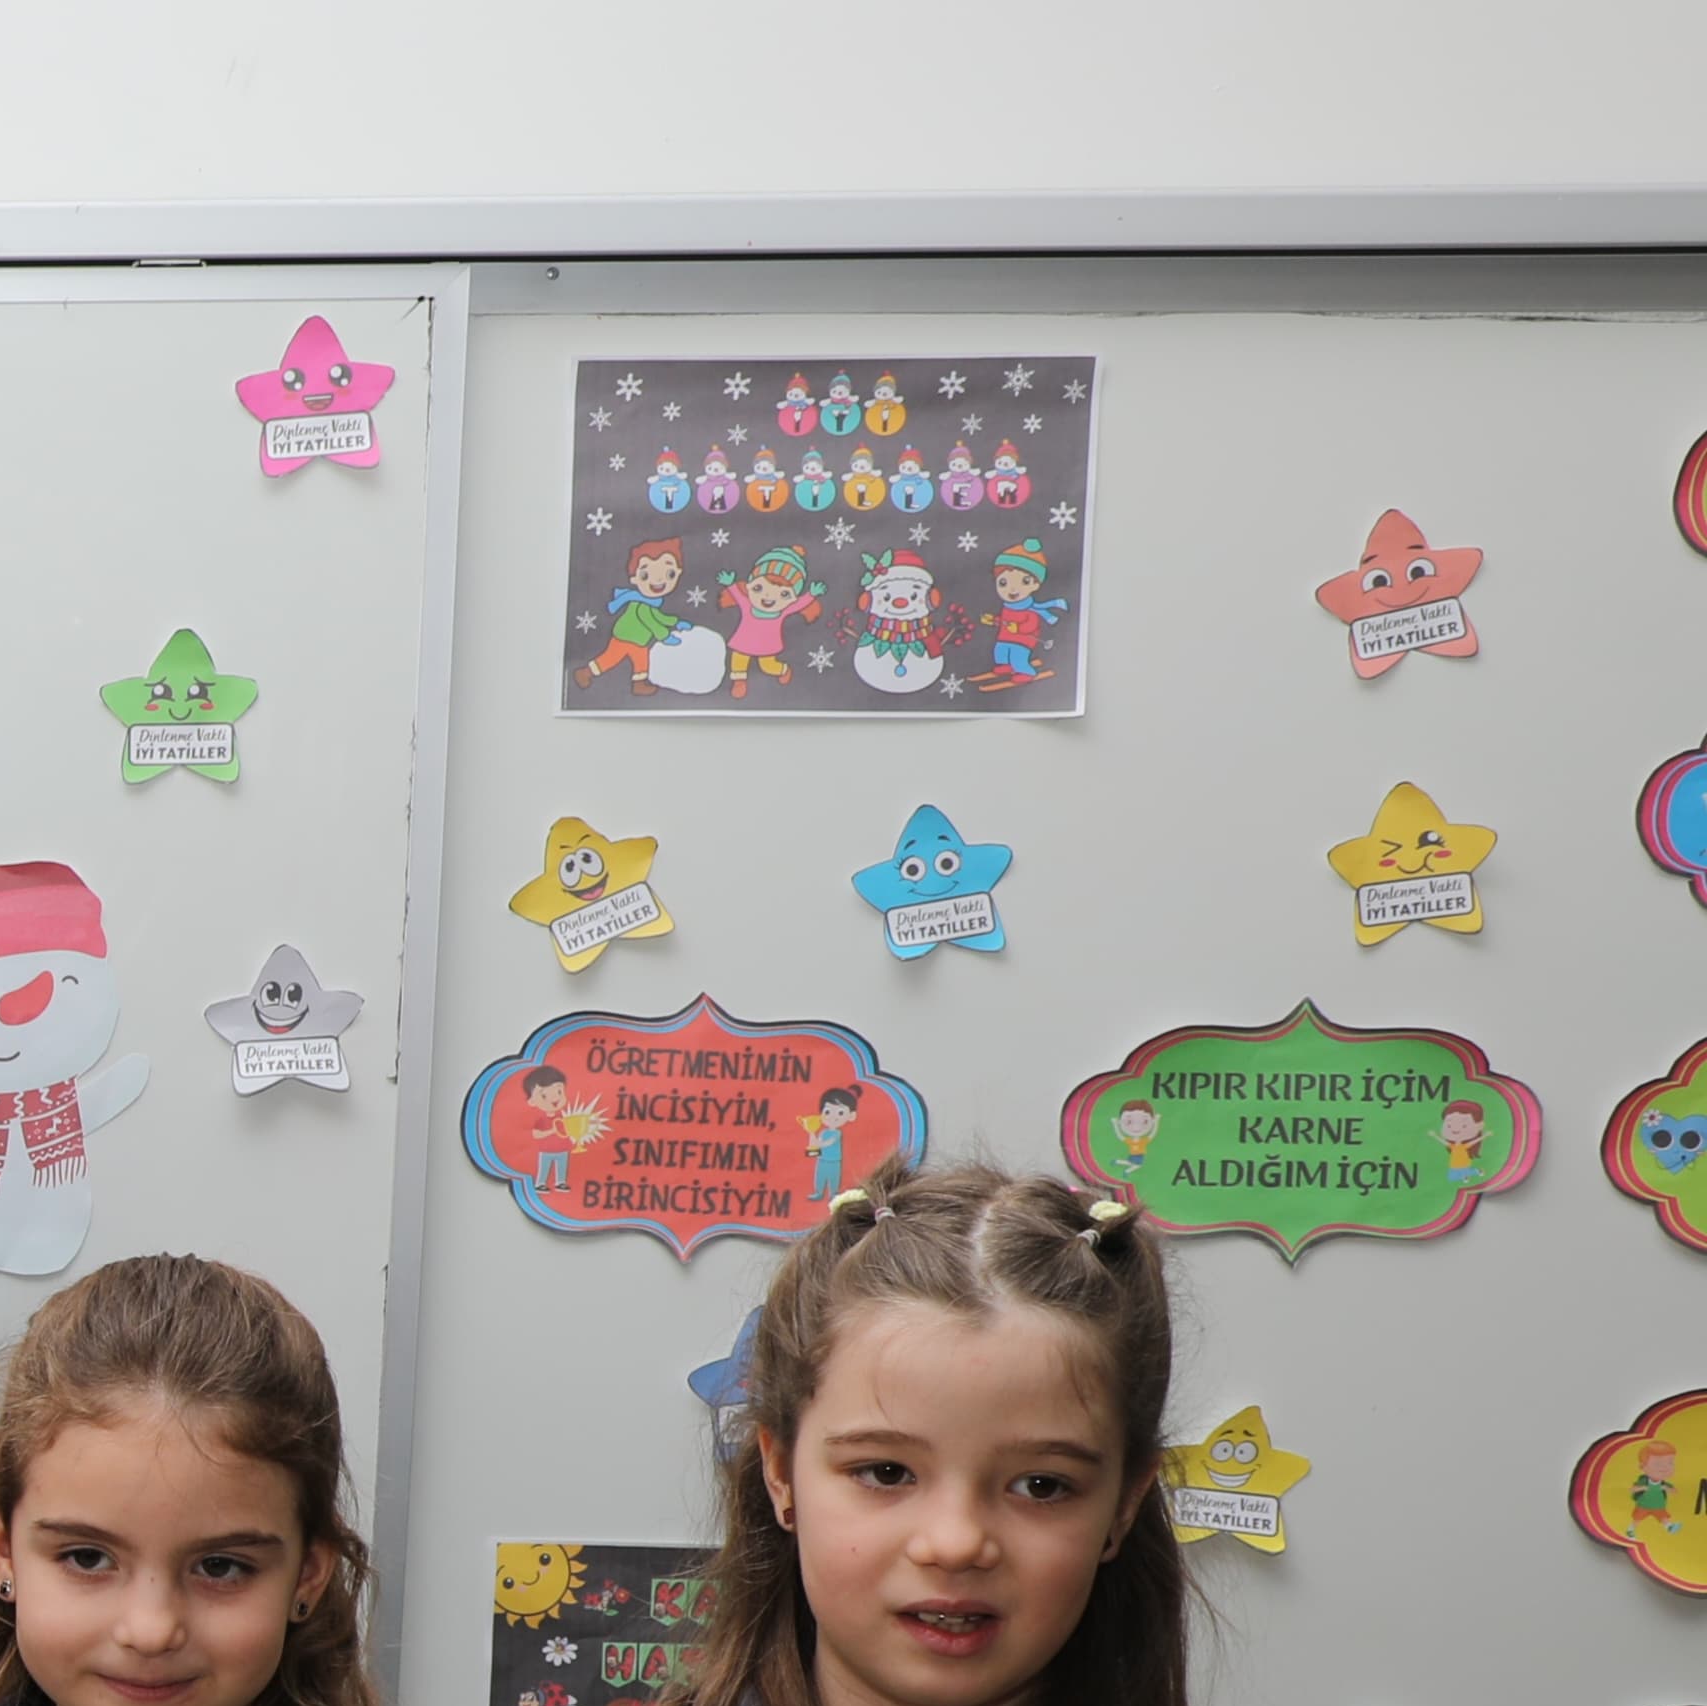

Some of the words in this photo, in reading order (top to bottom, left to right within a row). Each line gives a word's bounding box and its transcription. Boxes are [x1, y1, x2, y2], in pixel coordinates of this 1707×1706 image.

[296, 433, 365, 452] TATİLLER
[1386, 621, 1459, 648] TATİLLER
[159, 742, 227, 759] TATİLLER
[1390, 896, 1466, 916] TATİLLER
[588, 904, 653, 938] TATİLLER
[919, 916, 988, 939] TATİLLER
[267, 1055, 334, 1071] TATİLLER
[587, 1038, 812, 1083] ÖĞRETMENİMİN
[1152, 1072, 1247, 1100] KIPIR
[1256, 1073, 1352, 1101] KIPIR
[1361, 1068, 1450, 1109] İÇİM
[614, 1086, 776, 1131] İNCİSİYİM,
[1239, 1116, 1364, 1145] KARNE
[613, 1138, 769, 1172] SINIFIMIN
[1171, 1154, 1328, 1189] ALDIĞIM
[1336, 1155, 1418, 1196] İÇİN
[582, 1175, 792, 1218] BİRİNCİSİYİM
[1203, 1511, 1271, 1530] TATİLLER
